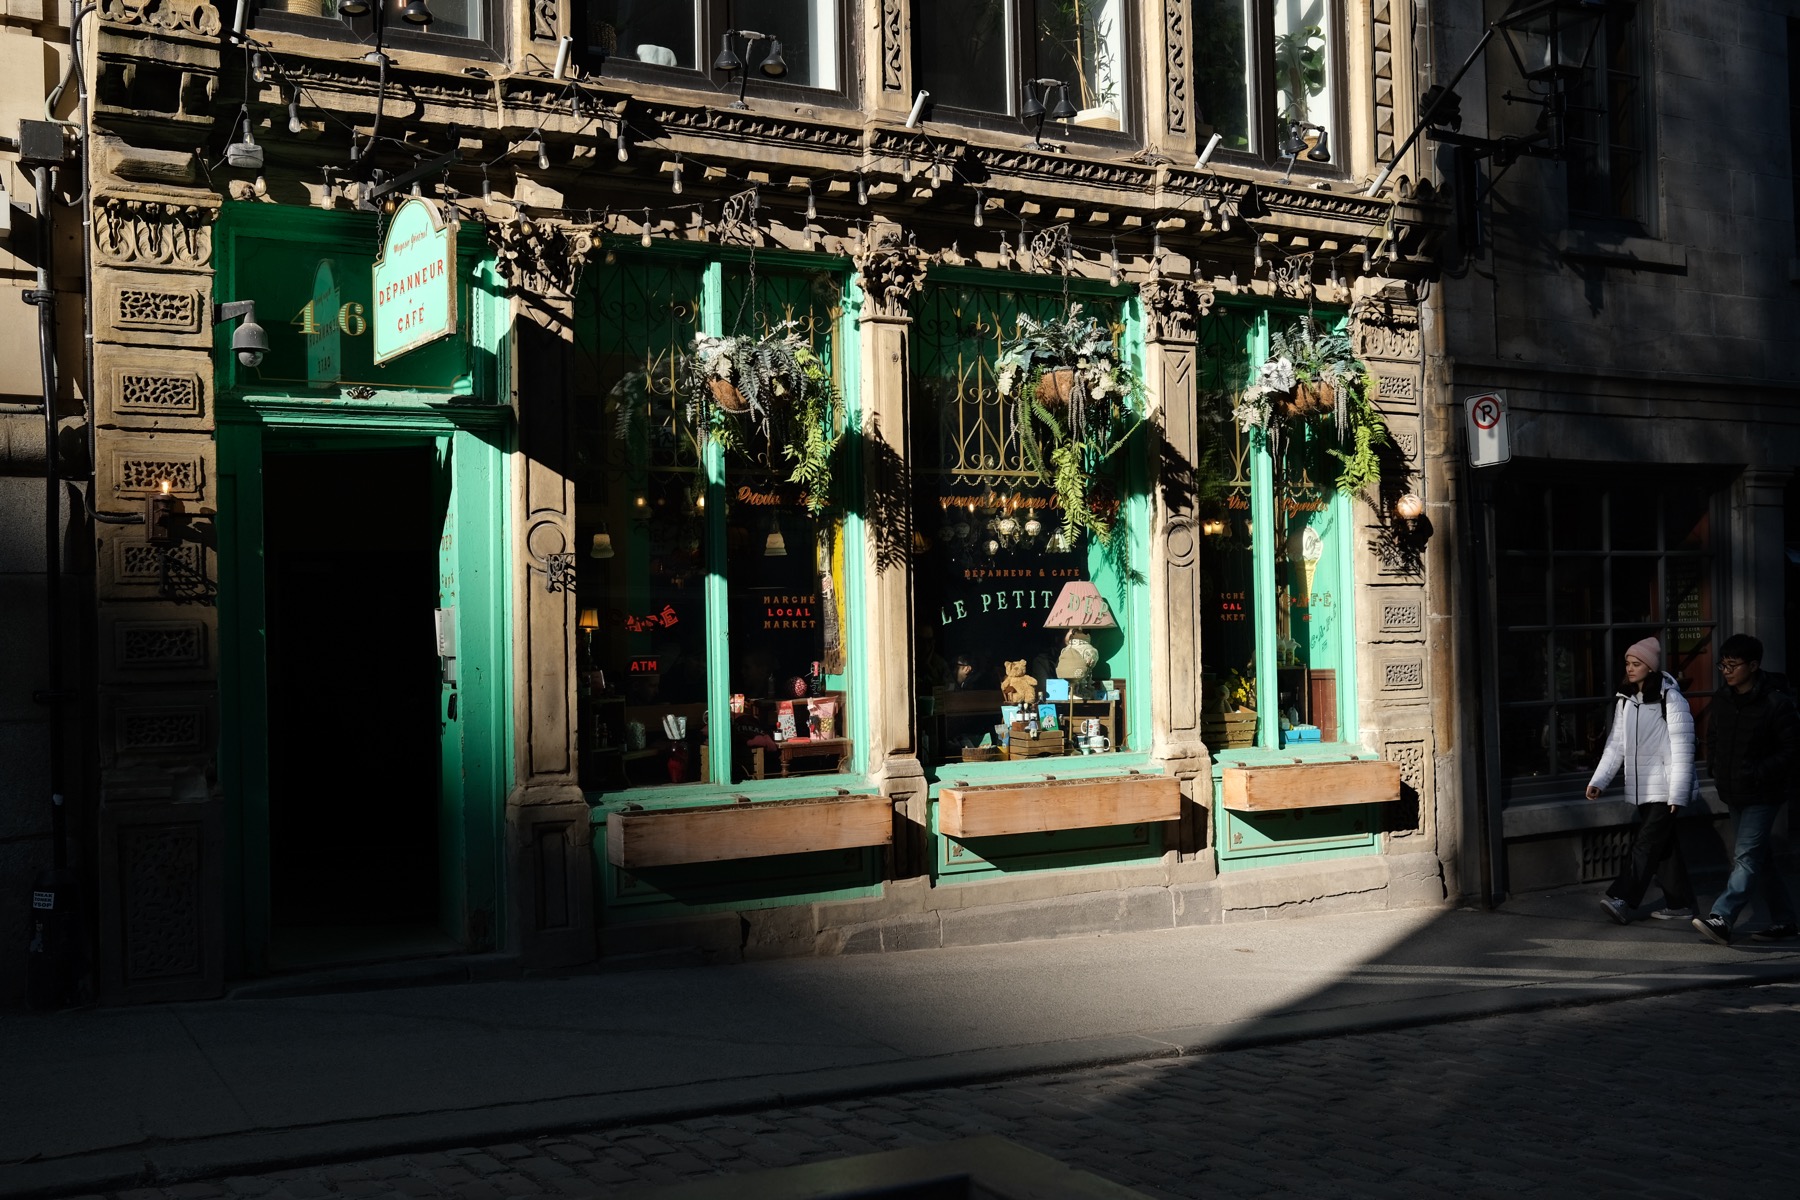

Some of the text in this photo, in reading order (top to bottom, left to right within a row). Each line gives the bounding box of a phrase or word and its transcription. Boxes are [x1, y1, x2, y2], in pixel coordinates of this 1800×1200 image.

[378, 258, 445, 308] DÉPANNEUR
[397, 303, 425, 333] CAFÉ
[963, 567, 1081, 578] DÉPANNEUR & CAFÉ
[763, 593, 816, 605] MARCHÉ
[767, 607, 811, 617] LOCAL
[939, 590, 1109, 626] LE PETIT DEP
[763, 619, 816, 629] MARKET
[630, 659, 657, 672] ATM
